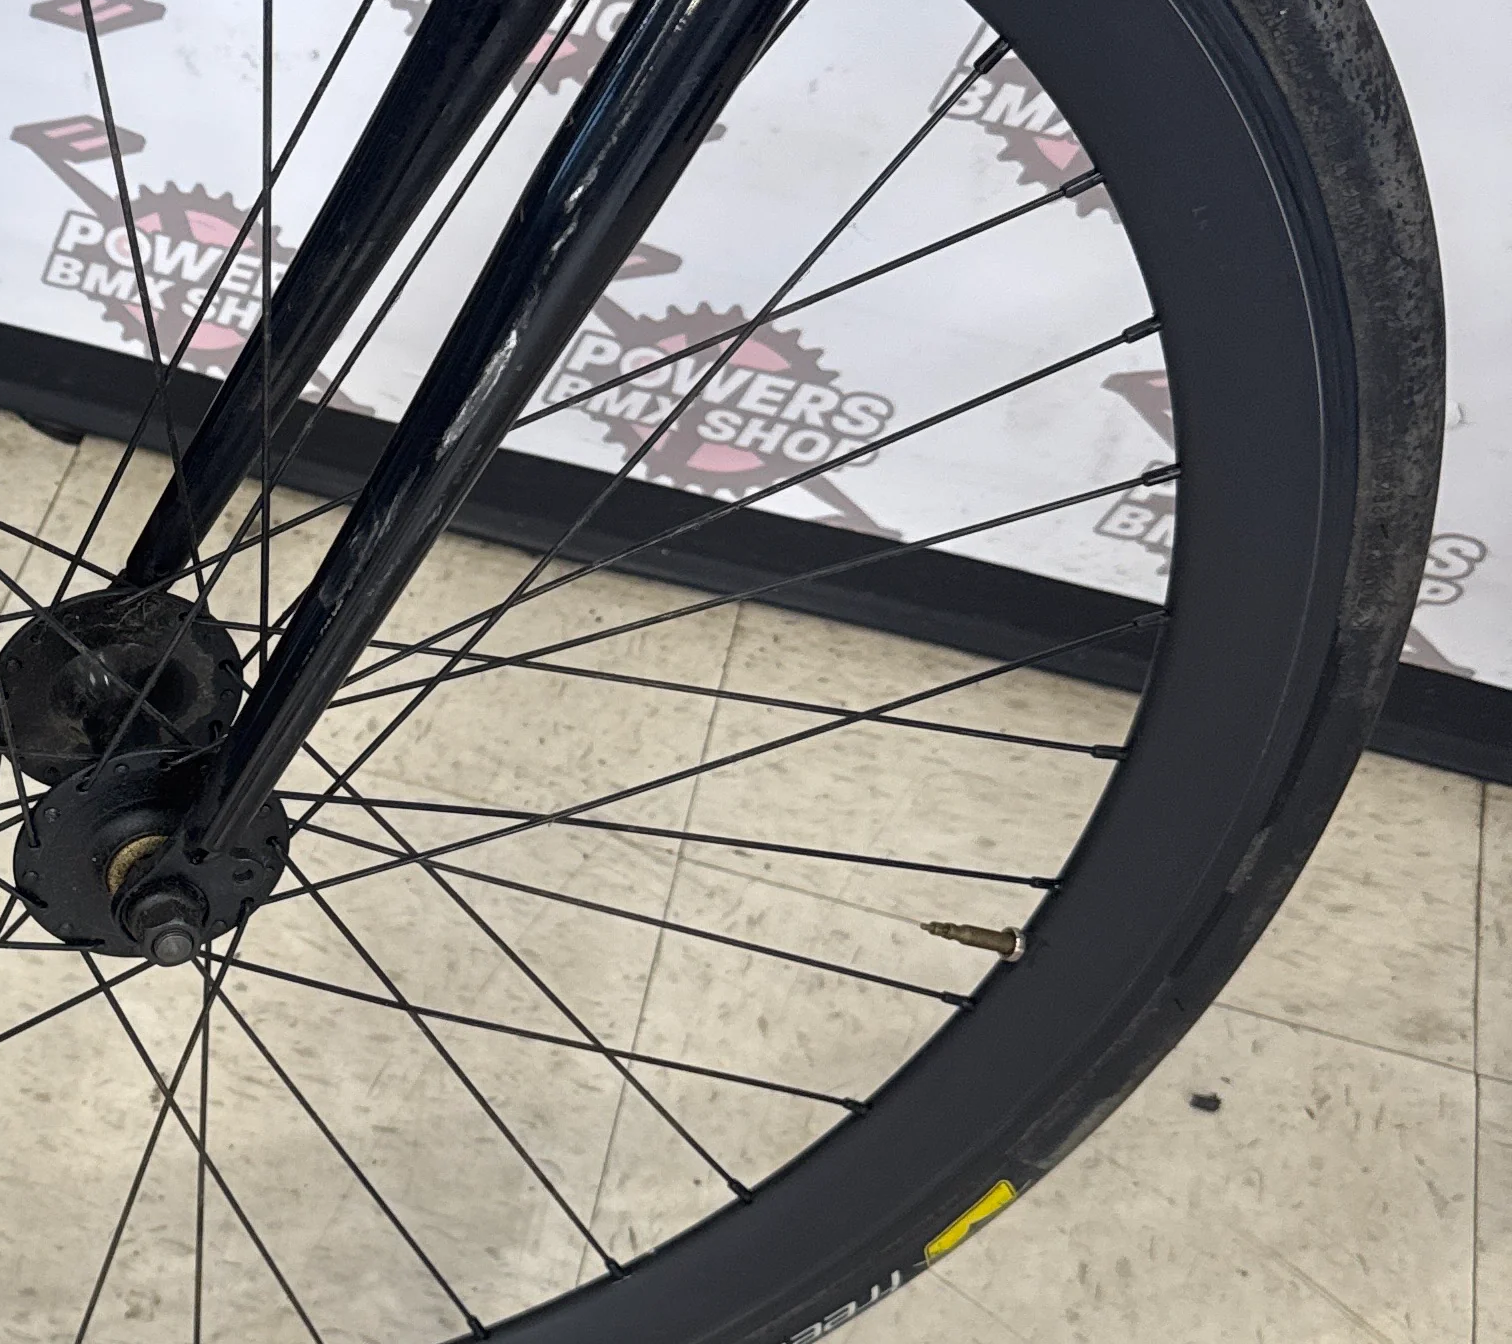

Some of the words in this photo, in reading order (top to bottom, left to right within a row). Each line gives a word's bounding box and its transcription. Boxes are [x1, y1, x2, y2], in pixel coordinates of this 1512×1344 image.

[46, 253, 176, 312] BMX
[567, 334, 889, 438] POWERS
[697, 409, 876, 467] SHOP
